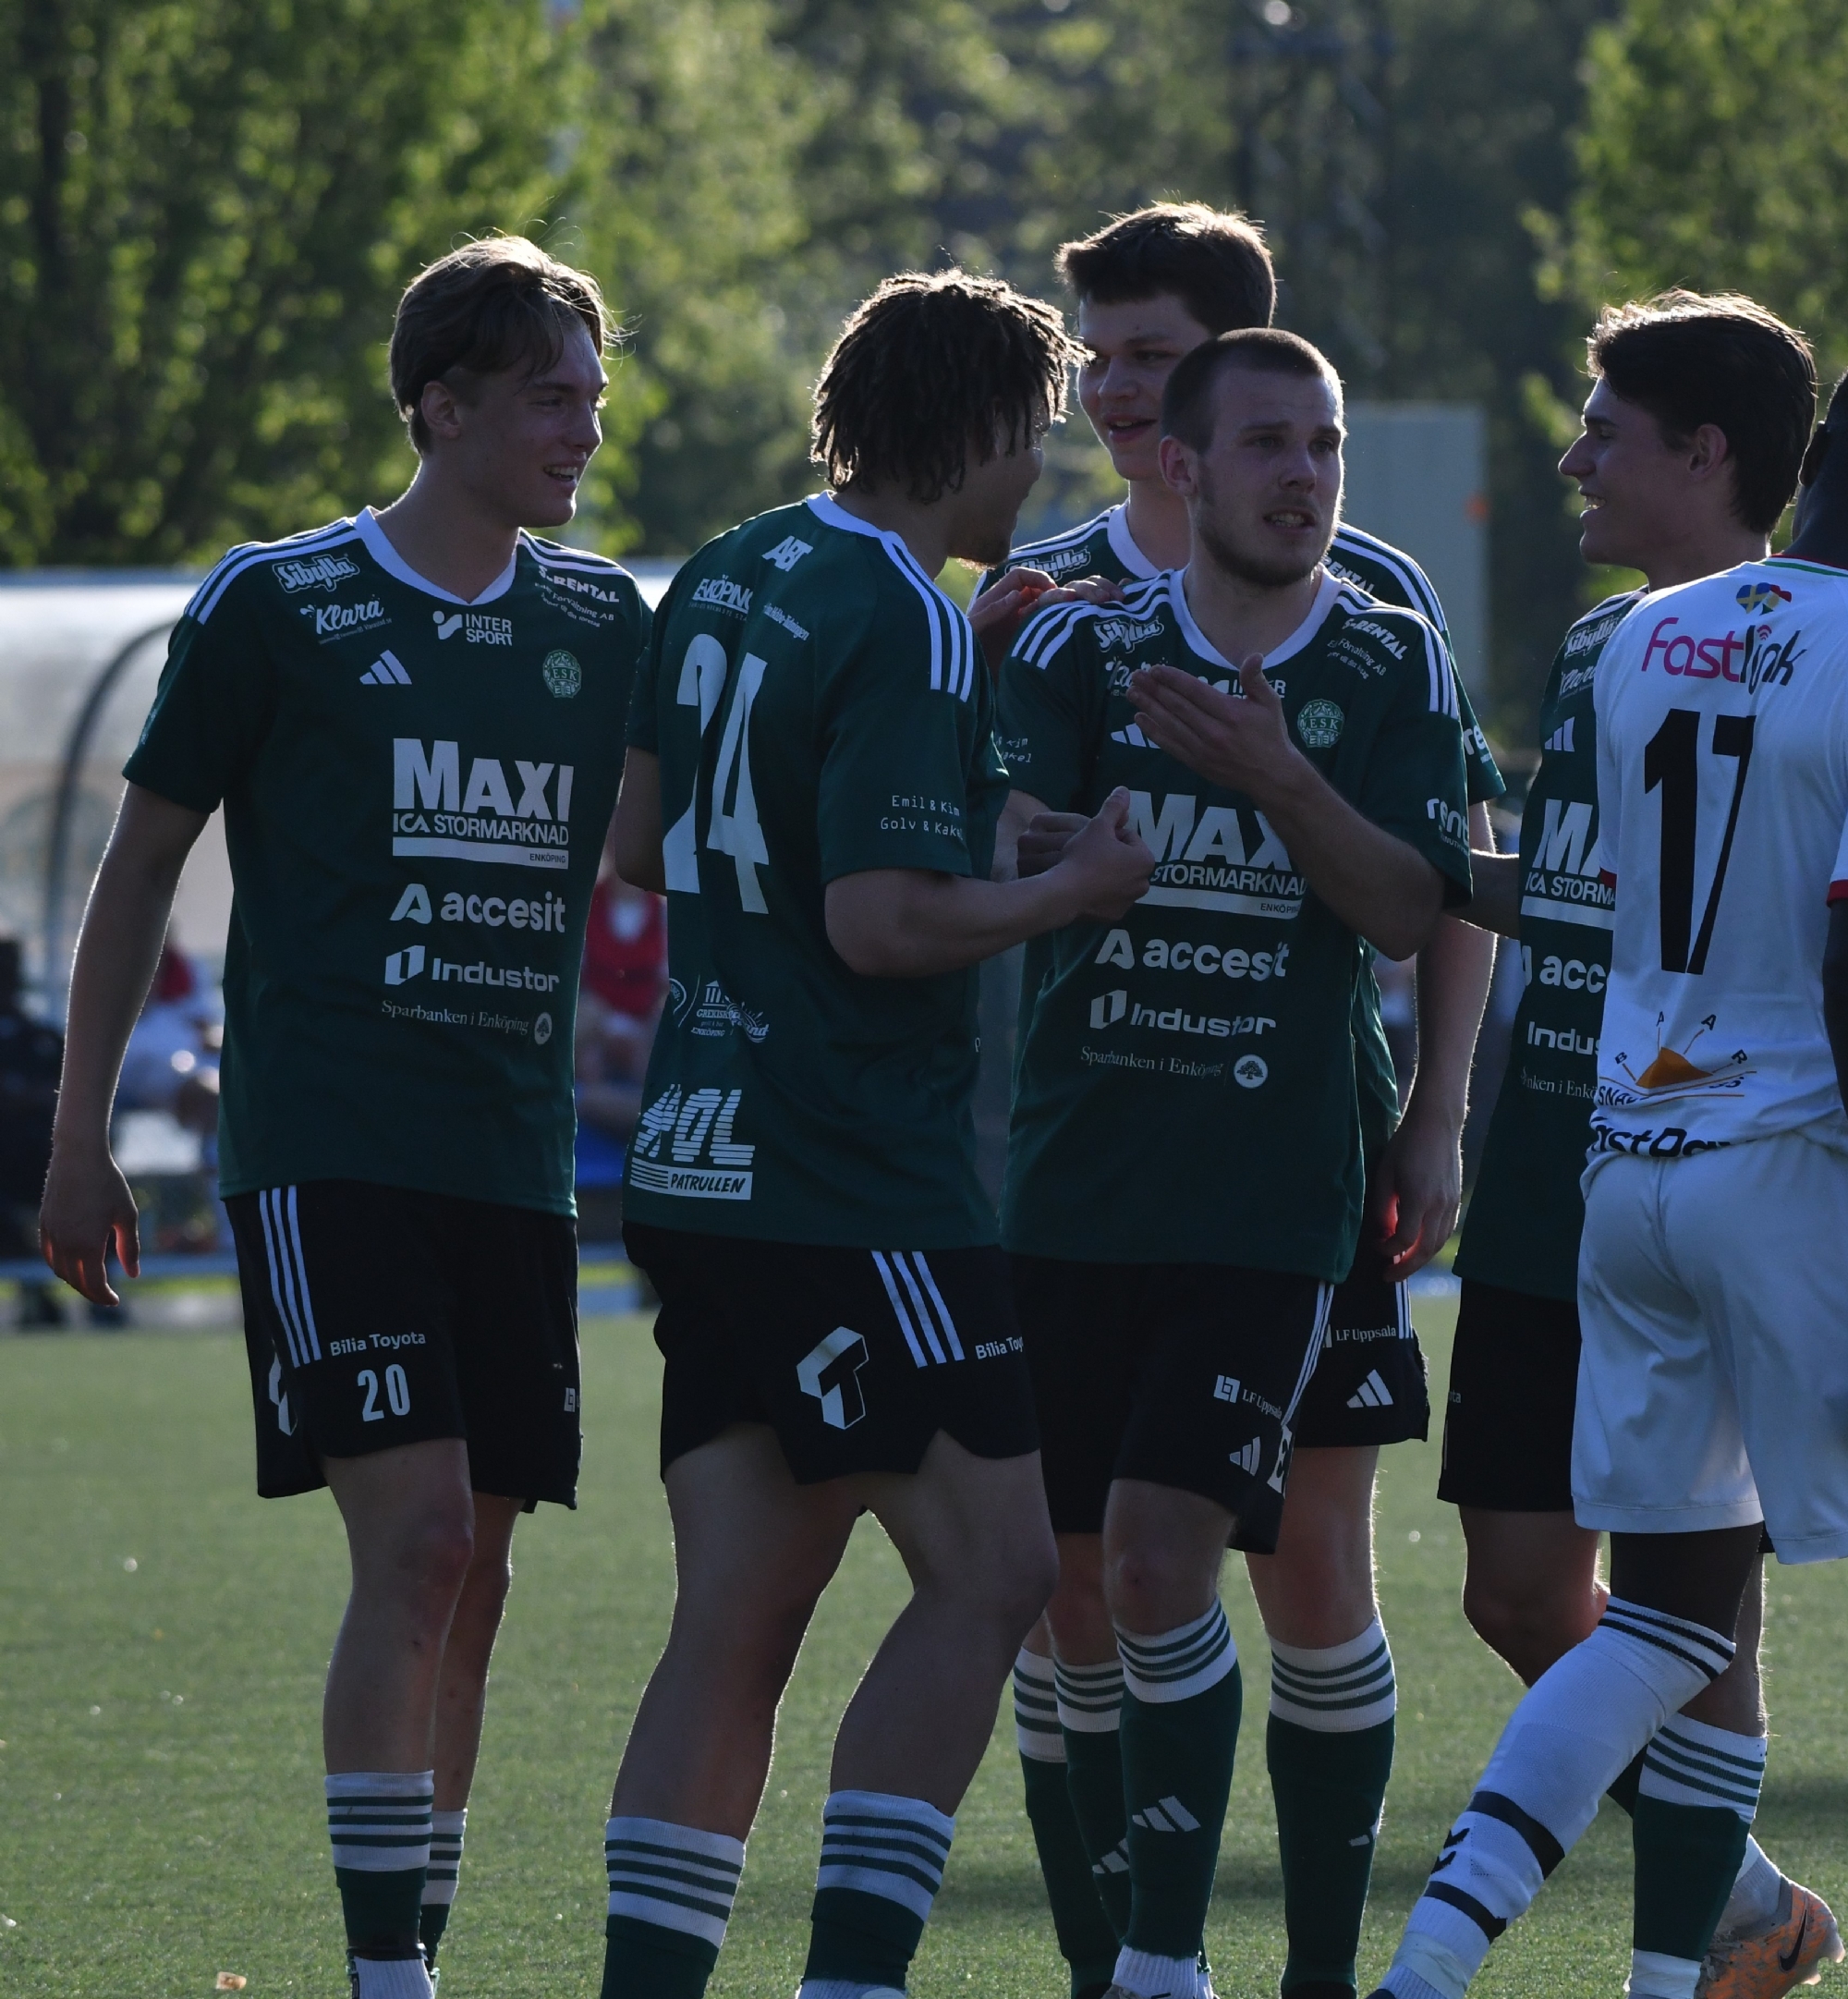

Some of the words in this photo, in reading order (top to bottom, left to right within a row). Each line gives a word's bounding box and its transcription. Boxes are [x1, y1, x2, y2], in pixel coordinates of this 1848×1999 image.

[276, 556, 358, 590] Sibylla
[466, 614, 513, 634] INTER
[466, 629, 513, 646] SPORT
[553, 668, 578, 681] ESK
[1309, 718, 1339, 730] ESK
[393, 738, 574, 822] MAXI
[662, 633, 770, 915] 24
[892, 795, 925, 810] Emil
[930, 799, 936, 811] &
[941, 800, 960, 817] Kim
[393, 812, 431, 834] ICA
[434, 815, 569, 846] STORMARKNAD
[881, 817, 917, 830] Golv
[923, 820, 930, 832] &
[1125, 789, 1293, 872] MAX
[1531, 798, 1600, 876] MA
[529, 853, 566, 863] ENKÖPING
[1645, 708, 1757, 975] 17
[440, 890, 566, 933] accesit
[432, 954, 560, 992] Industor
[1142, 941, 1291, 981] accesit
[382, 999, 468, 1025] Sparbanken
[469, 1012, 476, 1026] i
[478, 1011, 529, 1036] Enköping
[1130, 1002, 1277, 1037] Industor
[1160, 1057, 1164, 1070] i
[670, 1173, 746, 1193] PATRULLEN
[329, 1339, 367, 1357] Bilia
[369, 1331, 427, 1350] Toyota
[1336, 1329, 1350, 1341] LF
[1353, 1324, 1397, 1343] Uppsala
[975, 1344, 1008, 1360] Bilia
[357, 1363, 412, 1422] 20
[1241, 1388, 1258, 1404] LF
[1256, 1396, 1283, 1421] Uppsala
